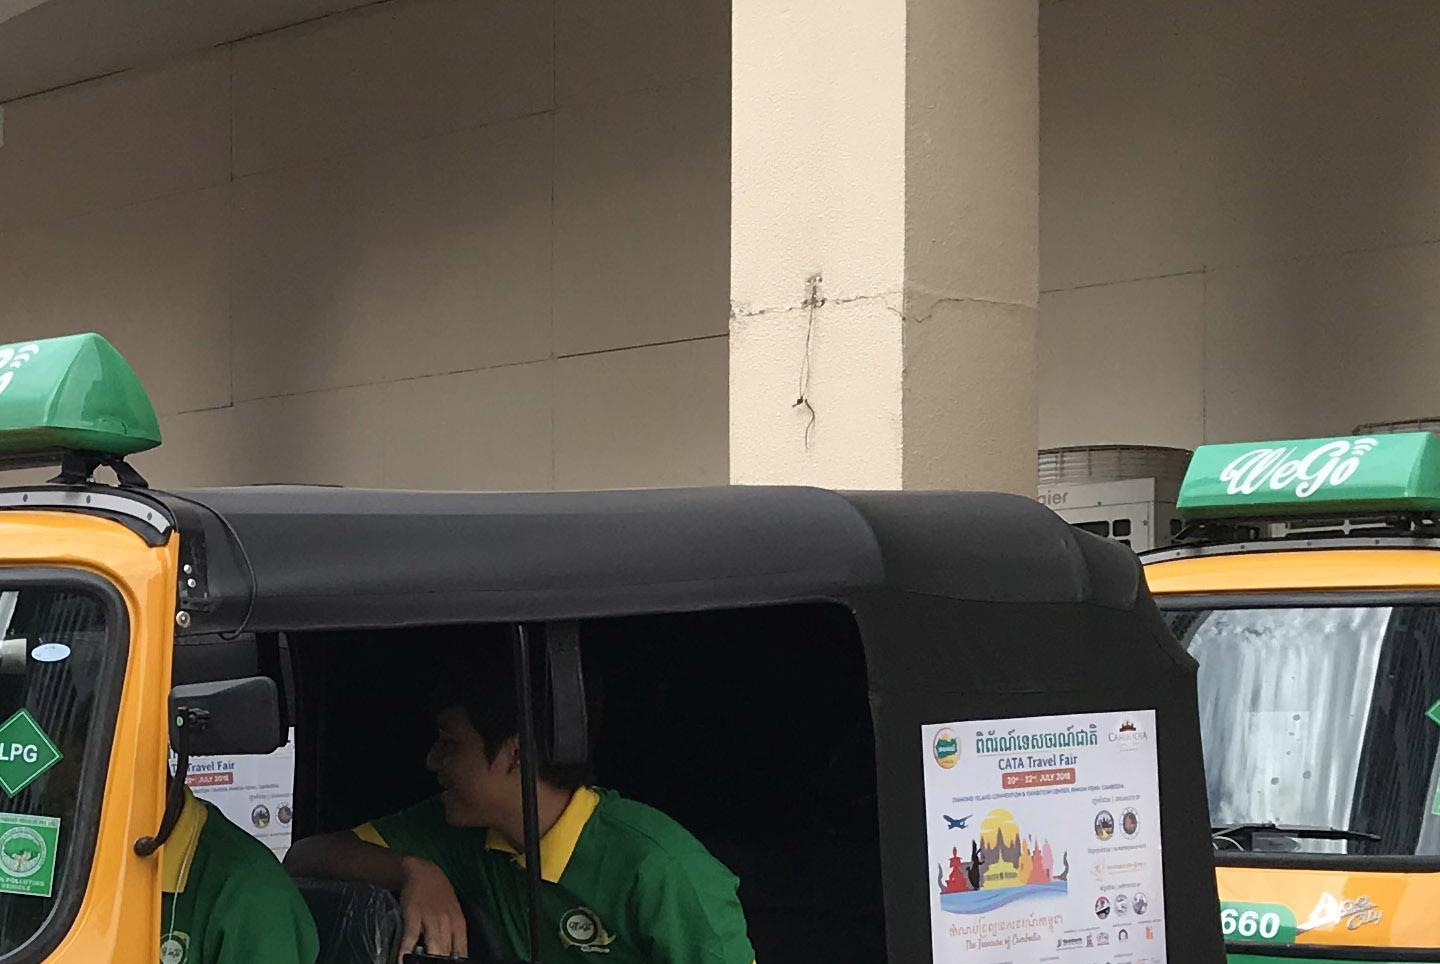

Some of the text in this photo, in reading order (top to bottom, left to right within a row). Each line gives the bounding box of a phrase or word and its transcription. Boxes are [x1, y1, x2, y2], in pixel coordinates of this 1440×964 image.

[1220, 440, 1364, 498] WeGo
[217, 760, 235, 771] Fair
[998, 753, 1078, 771] CATA Travel Fair
[1039, 772, 1054, 782] JULY
[1221, 908, 1281, 939] 660
[1347, 909, 1384, 931] City
